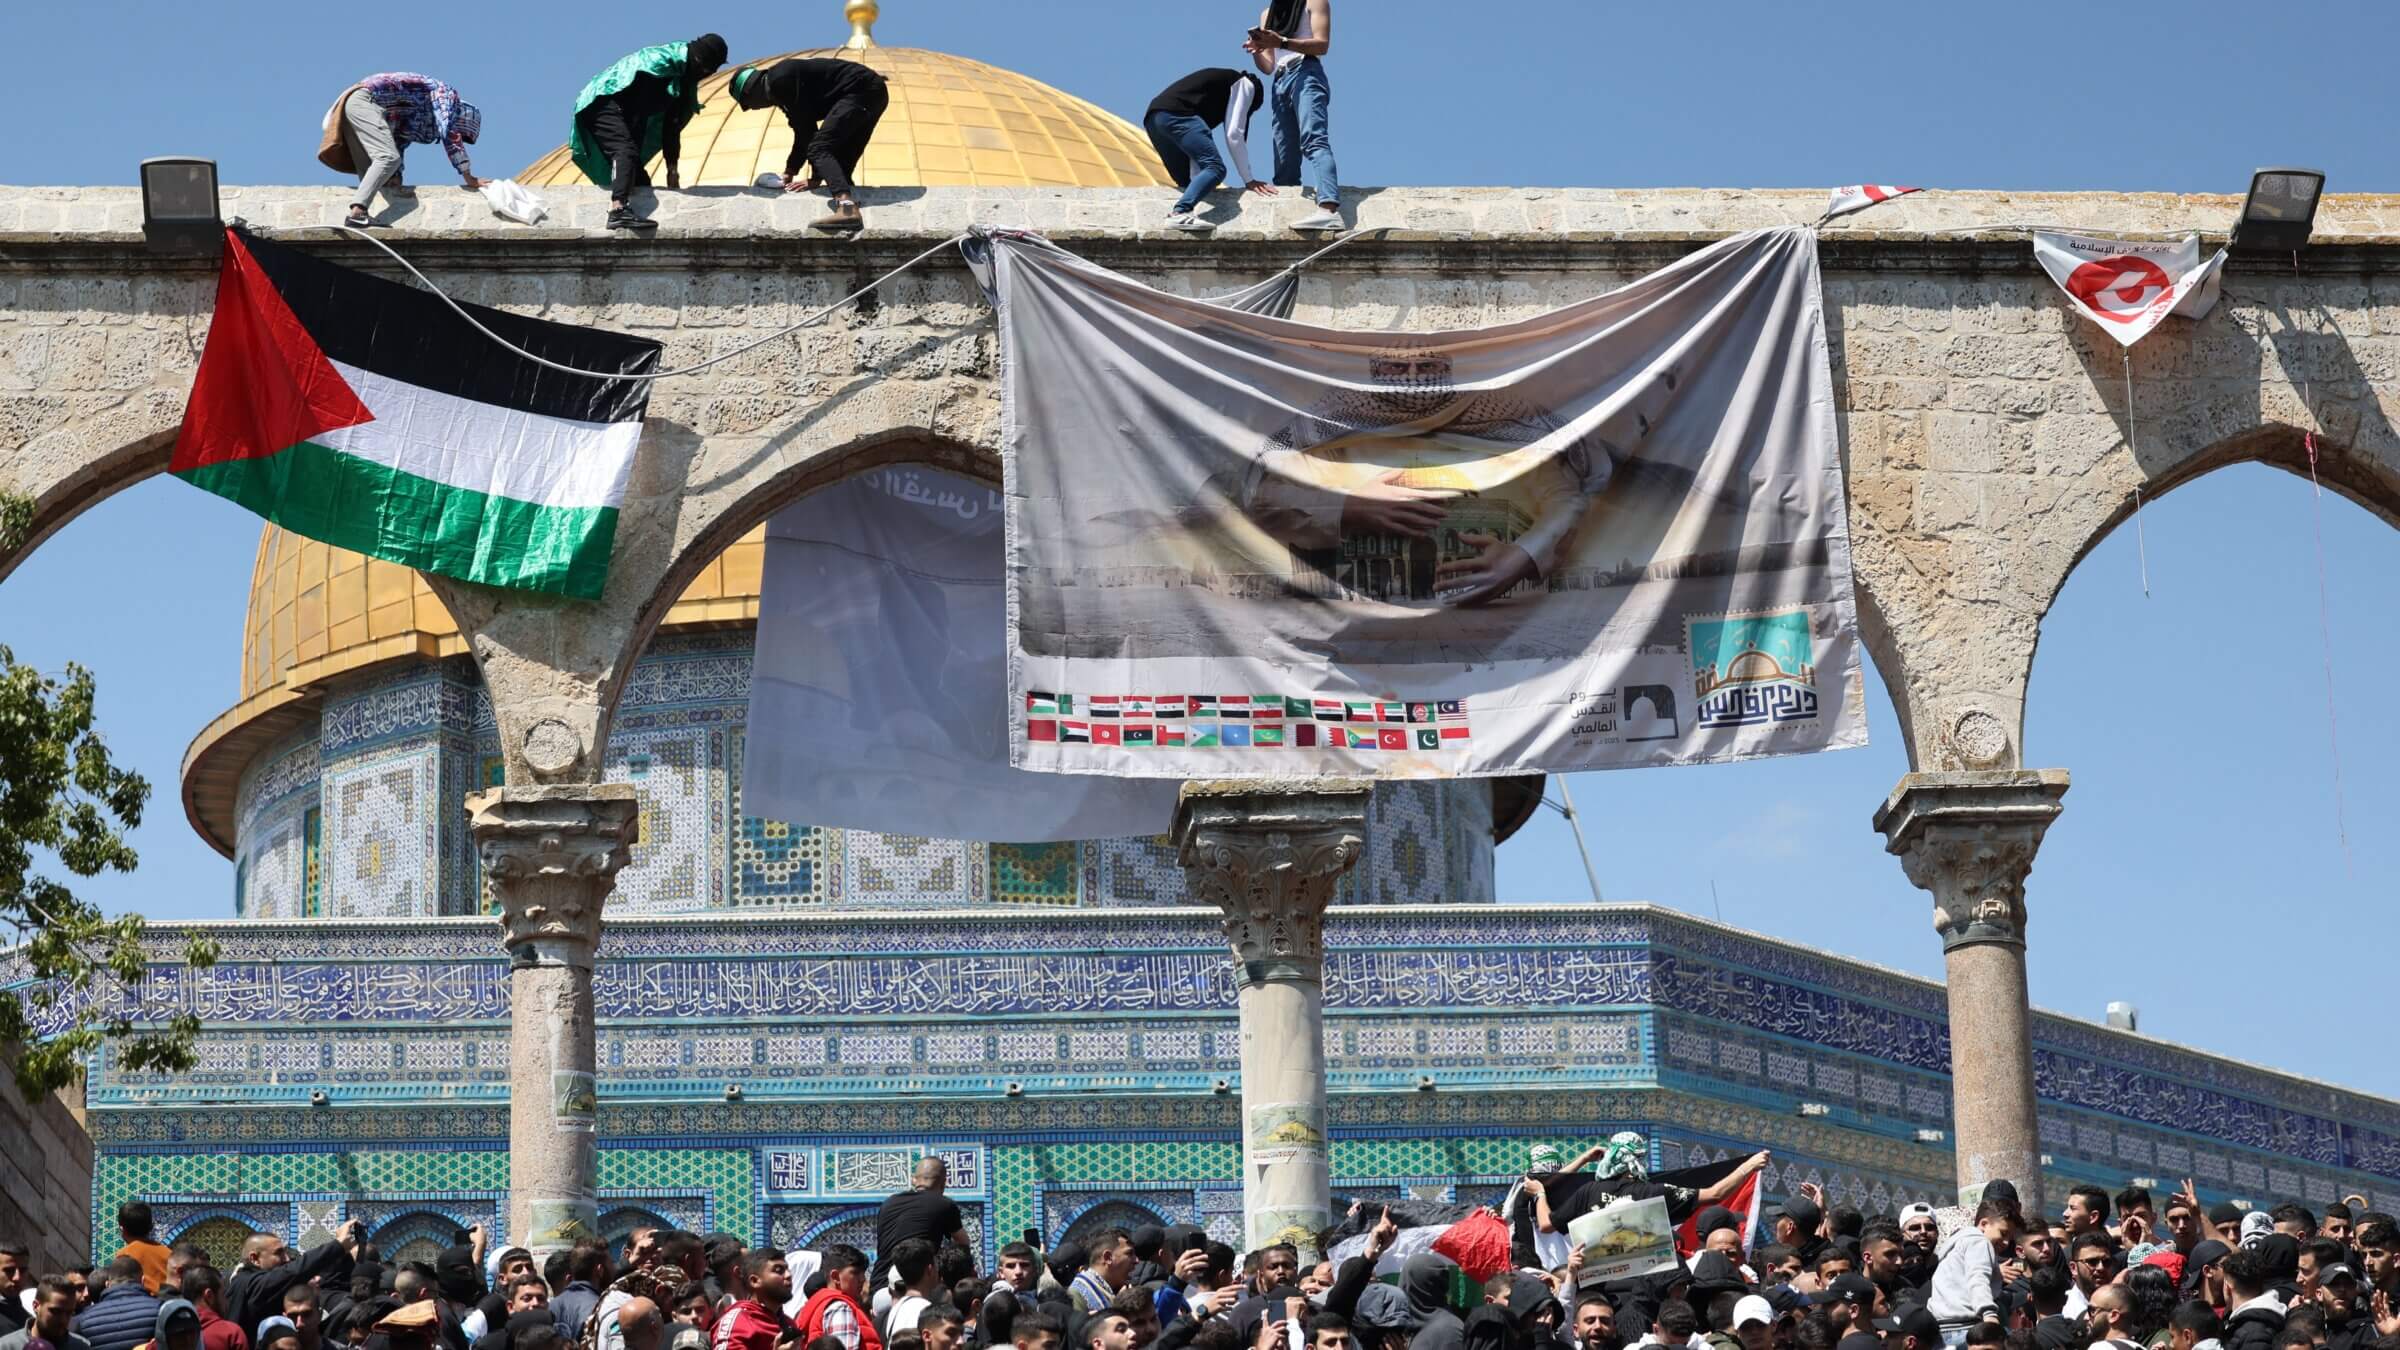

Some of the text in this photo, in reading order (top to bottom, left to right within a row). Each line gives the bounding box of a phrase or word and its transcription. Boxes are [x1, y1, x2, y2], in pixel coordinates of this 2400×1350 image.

[2070, 240, 2116, 256] الإسلامية
[1569, 687, 1617, 705] يوم
[1771, 684, 1818, 722] درع
[1571, 700, 1617, 719] القدس
[1571, 719, 1618, 738] العالمي
